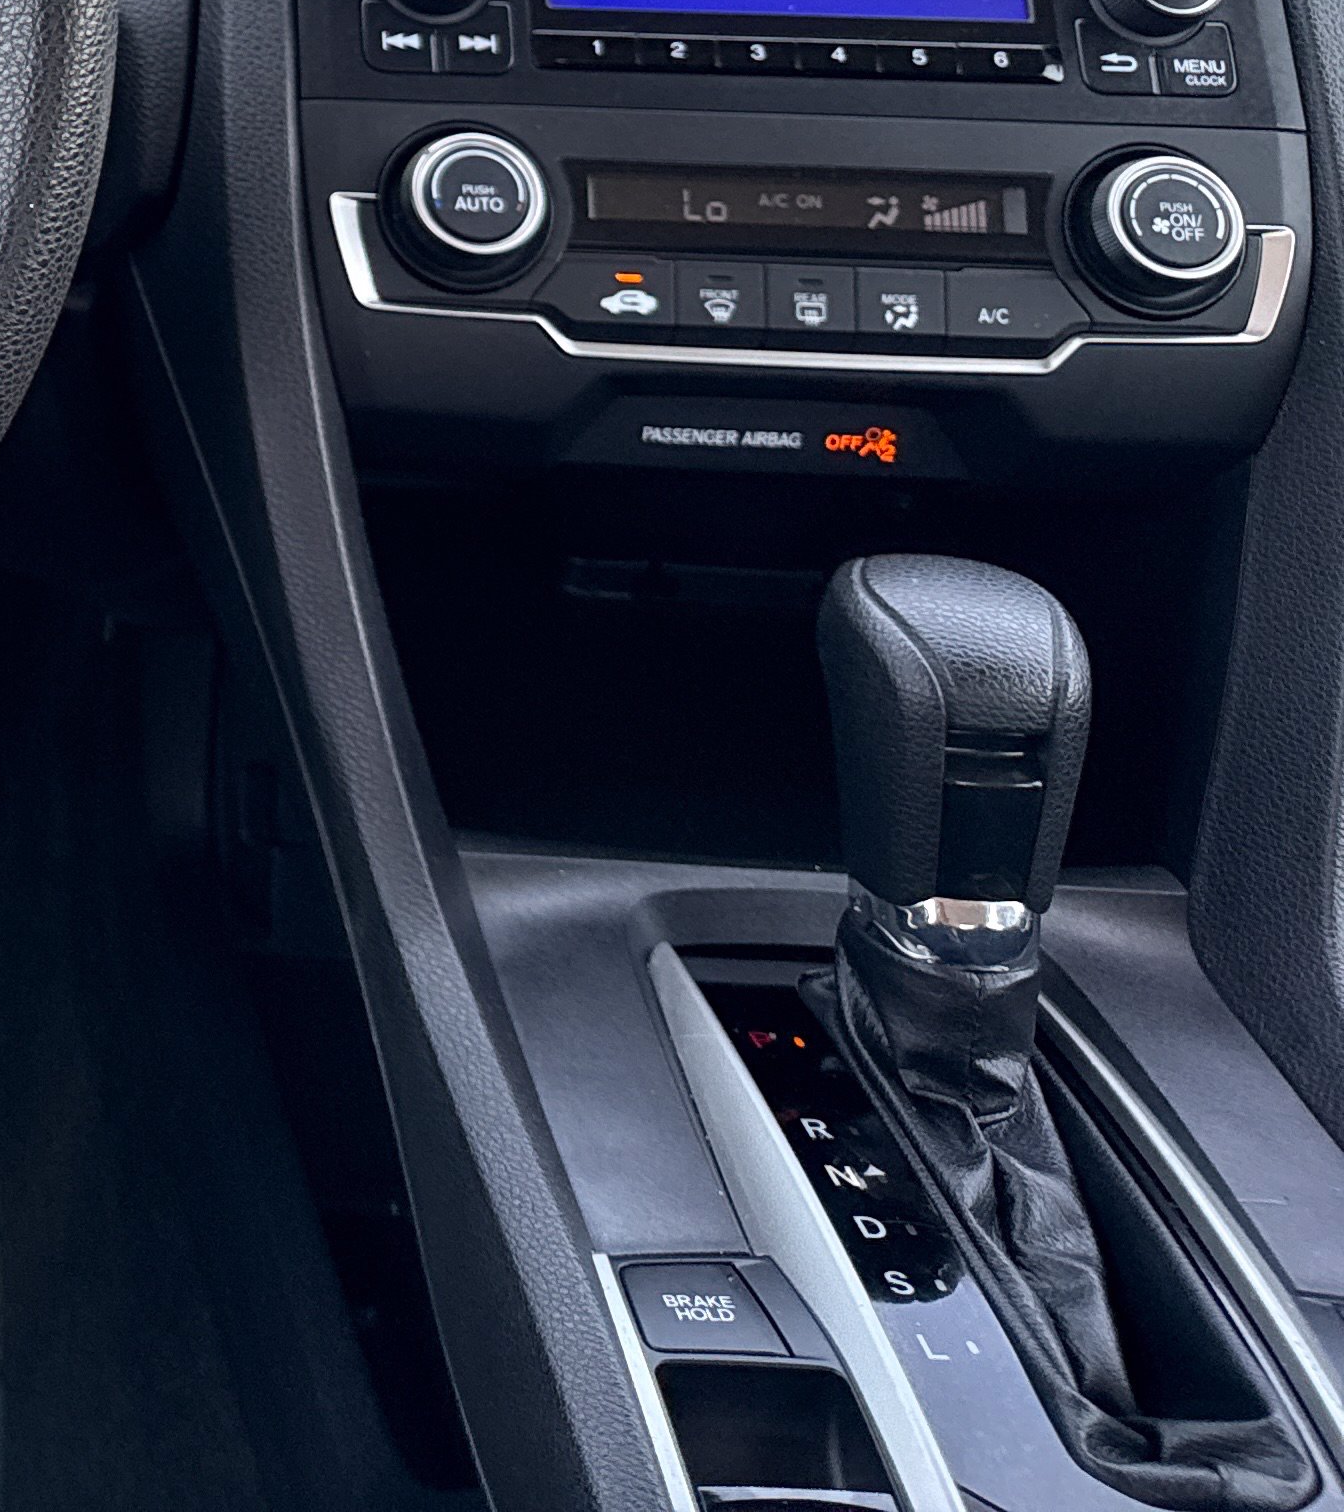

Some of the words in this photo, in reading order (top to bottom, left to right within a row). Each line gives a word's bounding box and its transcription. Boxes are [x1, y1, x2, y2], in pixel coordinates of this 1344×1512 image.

[592, 39, 605, 57] 1
[669, 41, 689, 60] 2
[749, 43, 769, 61] 3
[830, 46, 848, 64] 4
[911, 48, 929, 66] 5
[993, 51, 1010, 69] 6
[1173, 57, 1227, 75] MENU
[1185, 74, 1227, 87] CLOCK
[461, 182, 496, 196] PUSH
[453, 195, 505, 214] AUTO
[682, 188, 729, 223] Lo
[758, 192, 788, 209] A/C
[795, 193, 823, 210] ON
[1158, 201, 1195, 214] PUSH
[1170, 212, 1203, 229] ON/
[1171, 226, 1206, 243] OFF
[699, 288, 740, 301] FRONT
[793, 291, 828, 303] REAR
[881, 292, 919, 306] MODE
[978, 307, 1012, 325] A/C
[642, 425, 739, 448] PASSENGER
[740, 430, 803, 450] AIRBAG
[825, 434, 863, 452] OFF
[800, 1117, 834, 1140] R
[824, 1164, 865, 1190] N
[852, 1215, 887, 1239] D
[883, 1270, 915, 1296] S
[662, 1292, 736, 1310] BRAKE
[674, 1306, 736, 1323] HOLD
[915, 1333, 950, 1361] L
